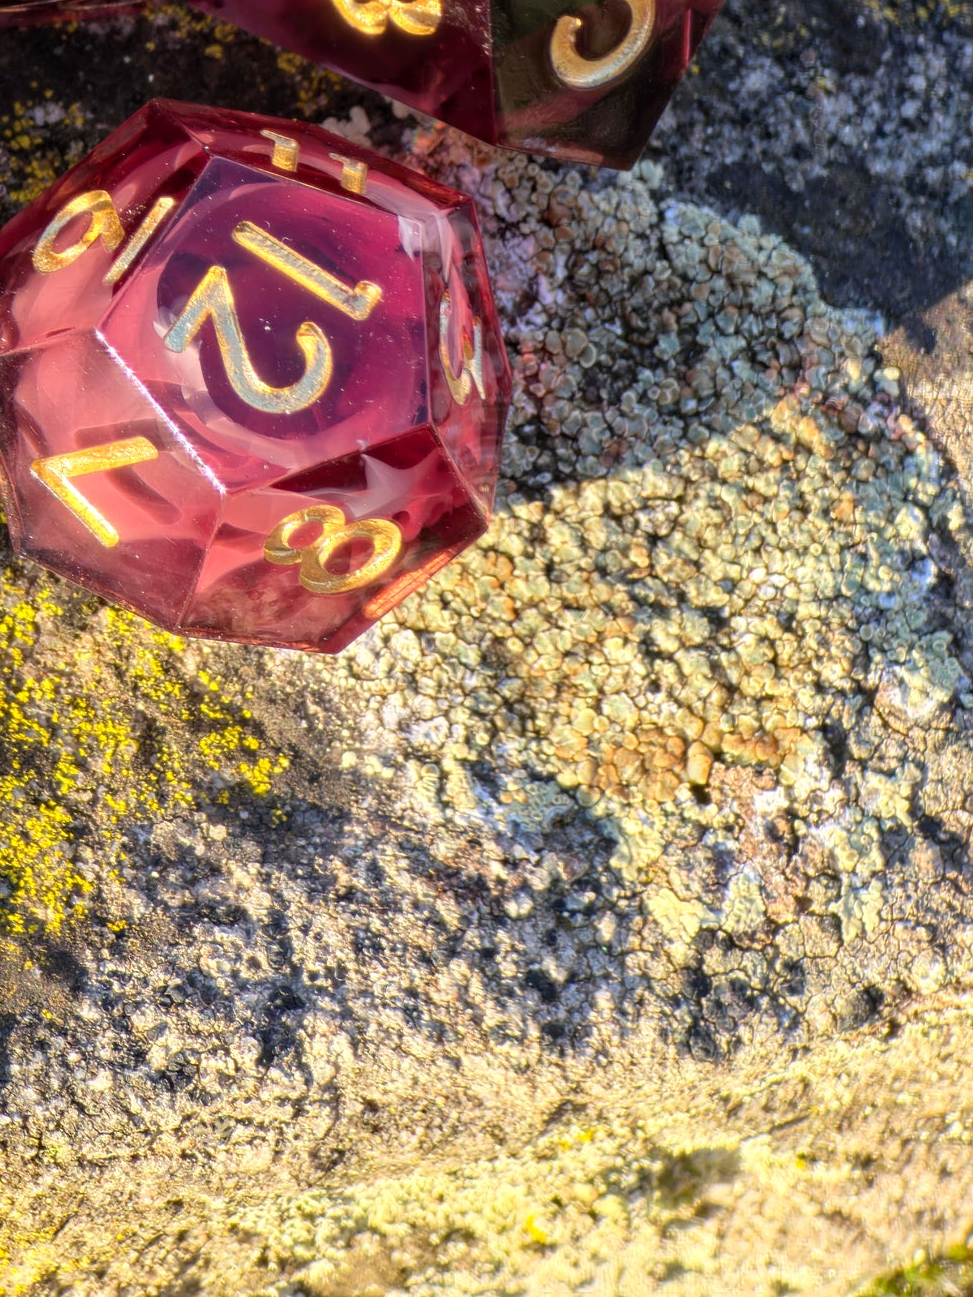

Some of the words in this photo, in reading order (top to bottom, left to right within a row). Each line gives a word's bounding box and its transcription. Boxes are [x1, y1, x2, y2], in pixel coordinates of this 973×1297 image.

[163, 220, 383, 414] 12
[30, 435, 159, 548] 7
[264, 504, 403, 595] 8
